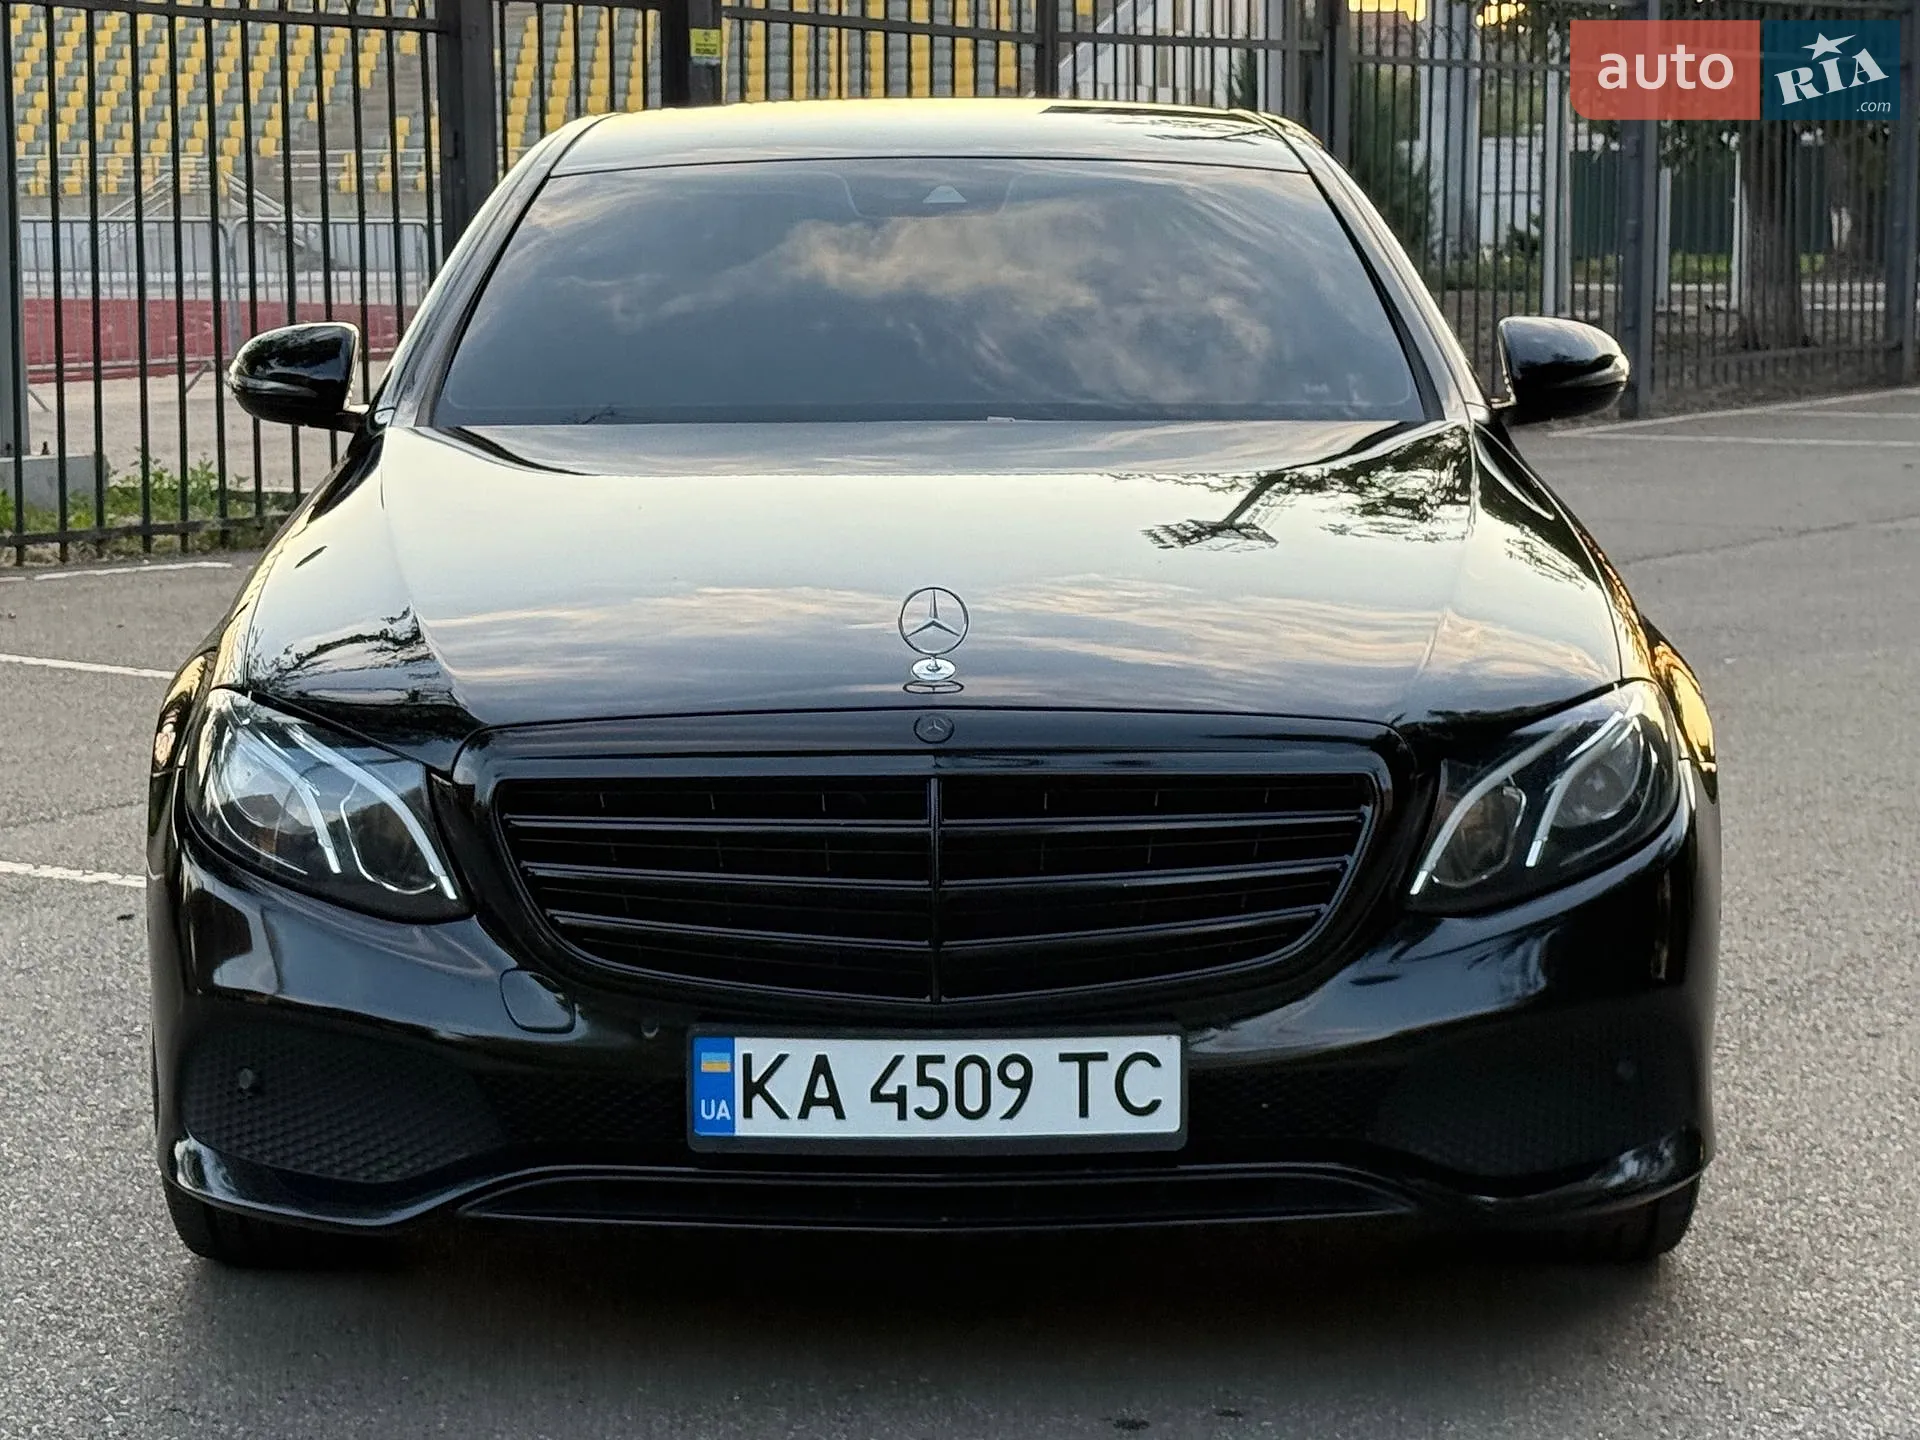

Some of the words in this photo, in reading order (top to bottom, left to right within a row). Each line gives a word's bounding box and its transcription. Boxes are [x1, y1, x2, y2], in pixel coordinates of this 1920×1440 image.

[742, 1052, 847, 1120] KA
[870, 1053, 1034, 1121] 4509
[1058, 1051, 1163, 1118] TC
[700, 1100, 732, 1121] UA
